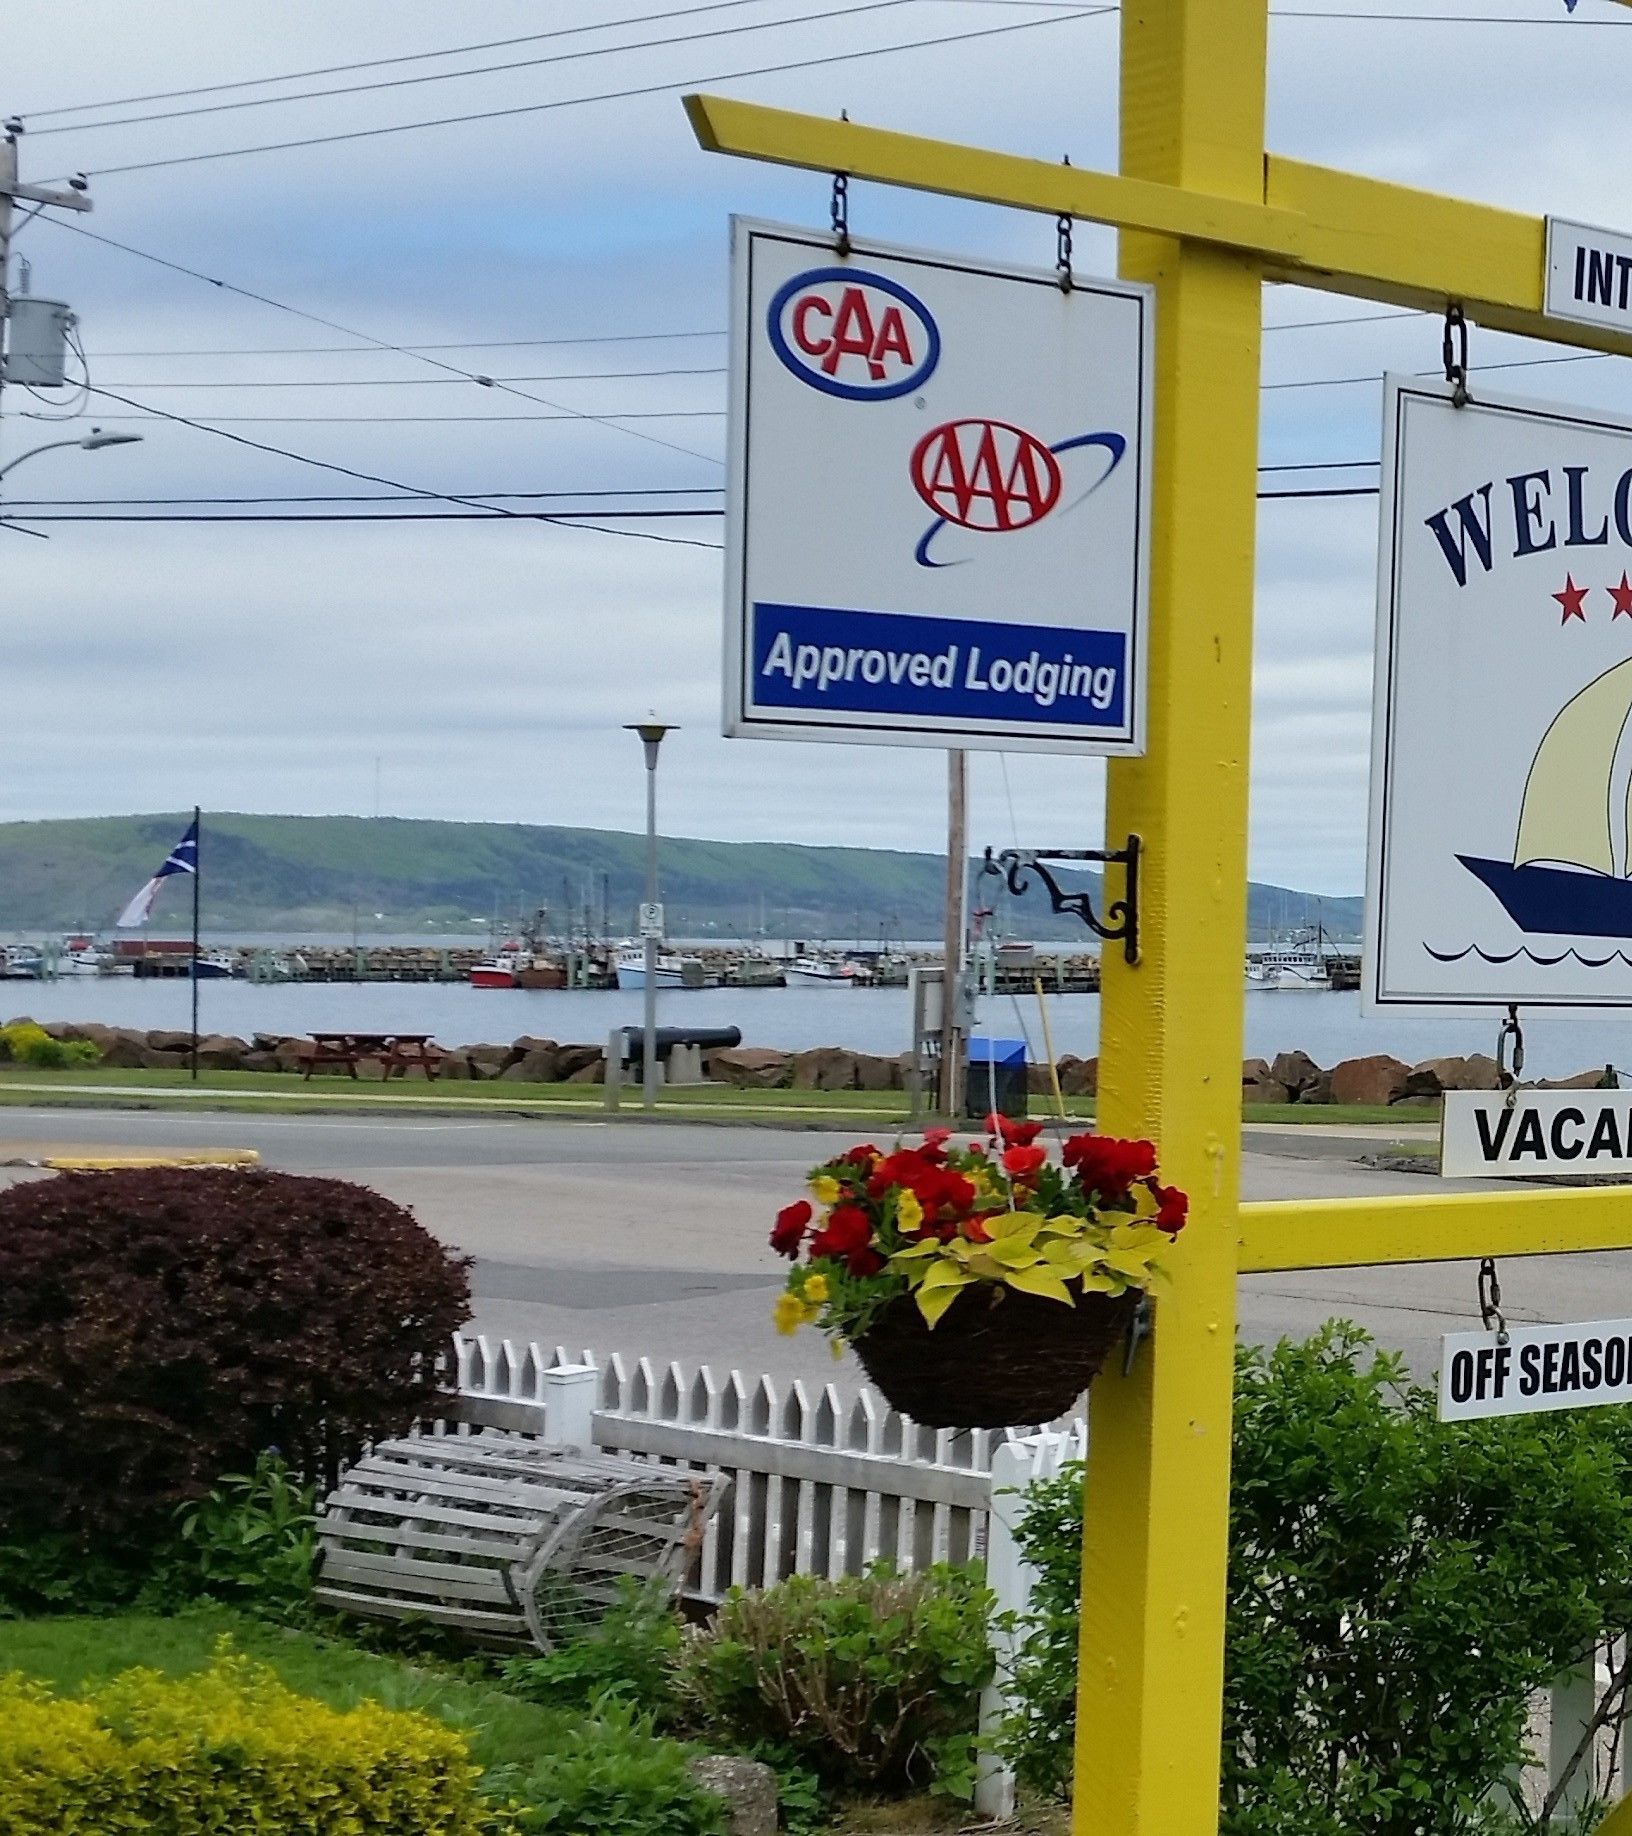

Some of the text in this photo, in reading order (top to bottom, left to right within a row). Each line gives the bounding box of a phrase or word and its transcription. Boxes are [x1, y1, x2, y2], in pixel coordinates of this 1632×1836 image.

[792, 288, 914, 381] CAA
[925, 423, 1050, 531] AAA
[762, 632, 1116, 709] Approved Lodging
[1451, 1346, 1512, 1403] OFF
